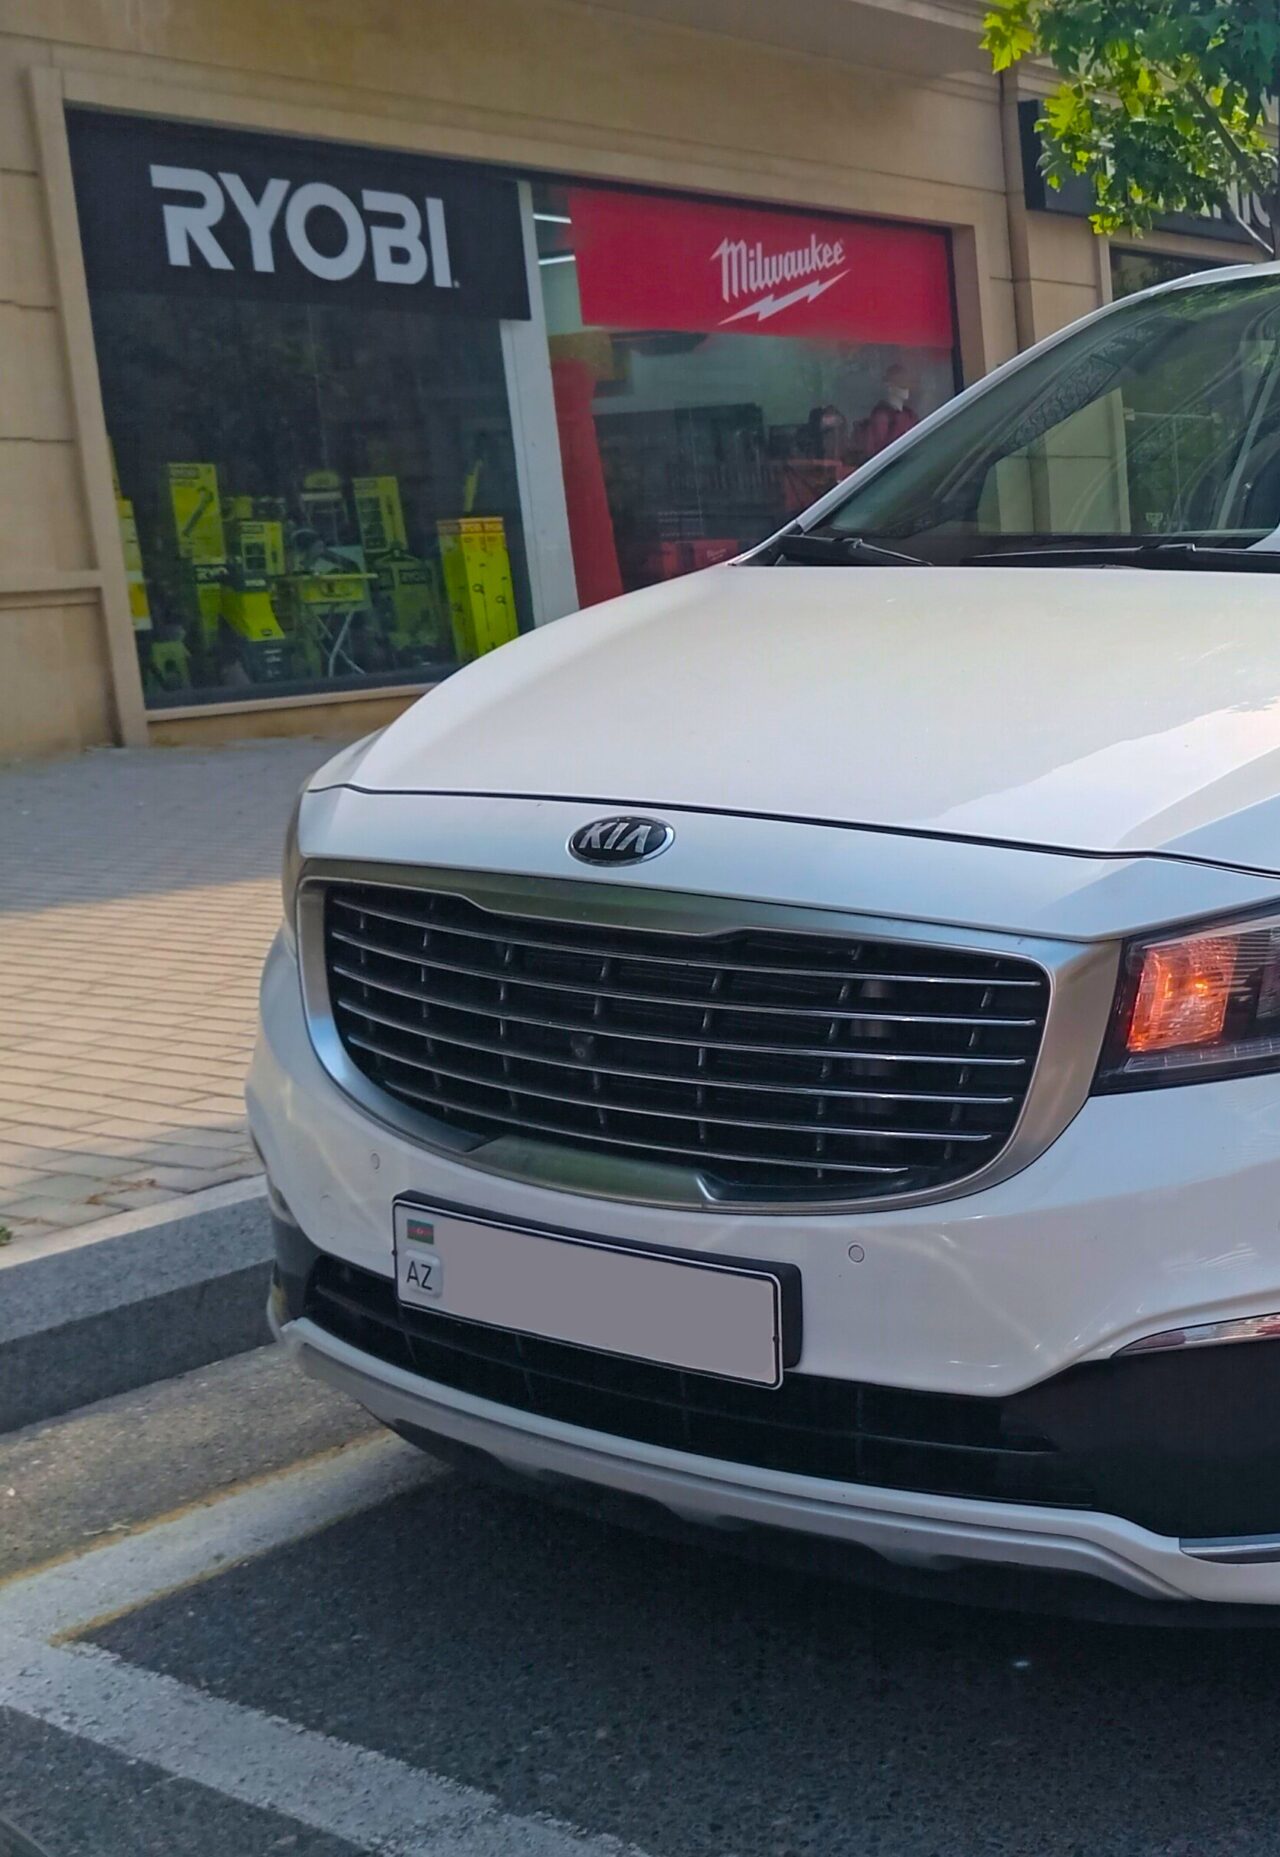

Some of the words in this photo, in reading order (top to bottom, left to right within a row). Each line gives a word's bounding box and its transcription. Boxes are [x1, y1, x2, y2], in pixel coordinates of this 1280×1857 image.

[149, 164, 455, 289] RYOBI
[709, 233, 846, 303] Milwaukee
[578, 821, 652, 854] KIA
[406, 1260, 433, 1291] AZ
